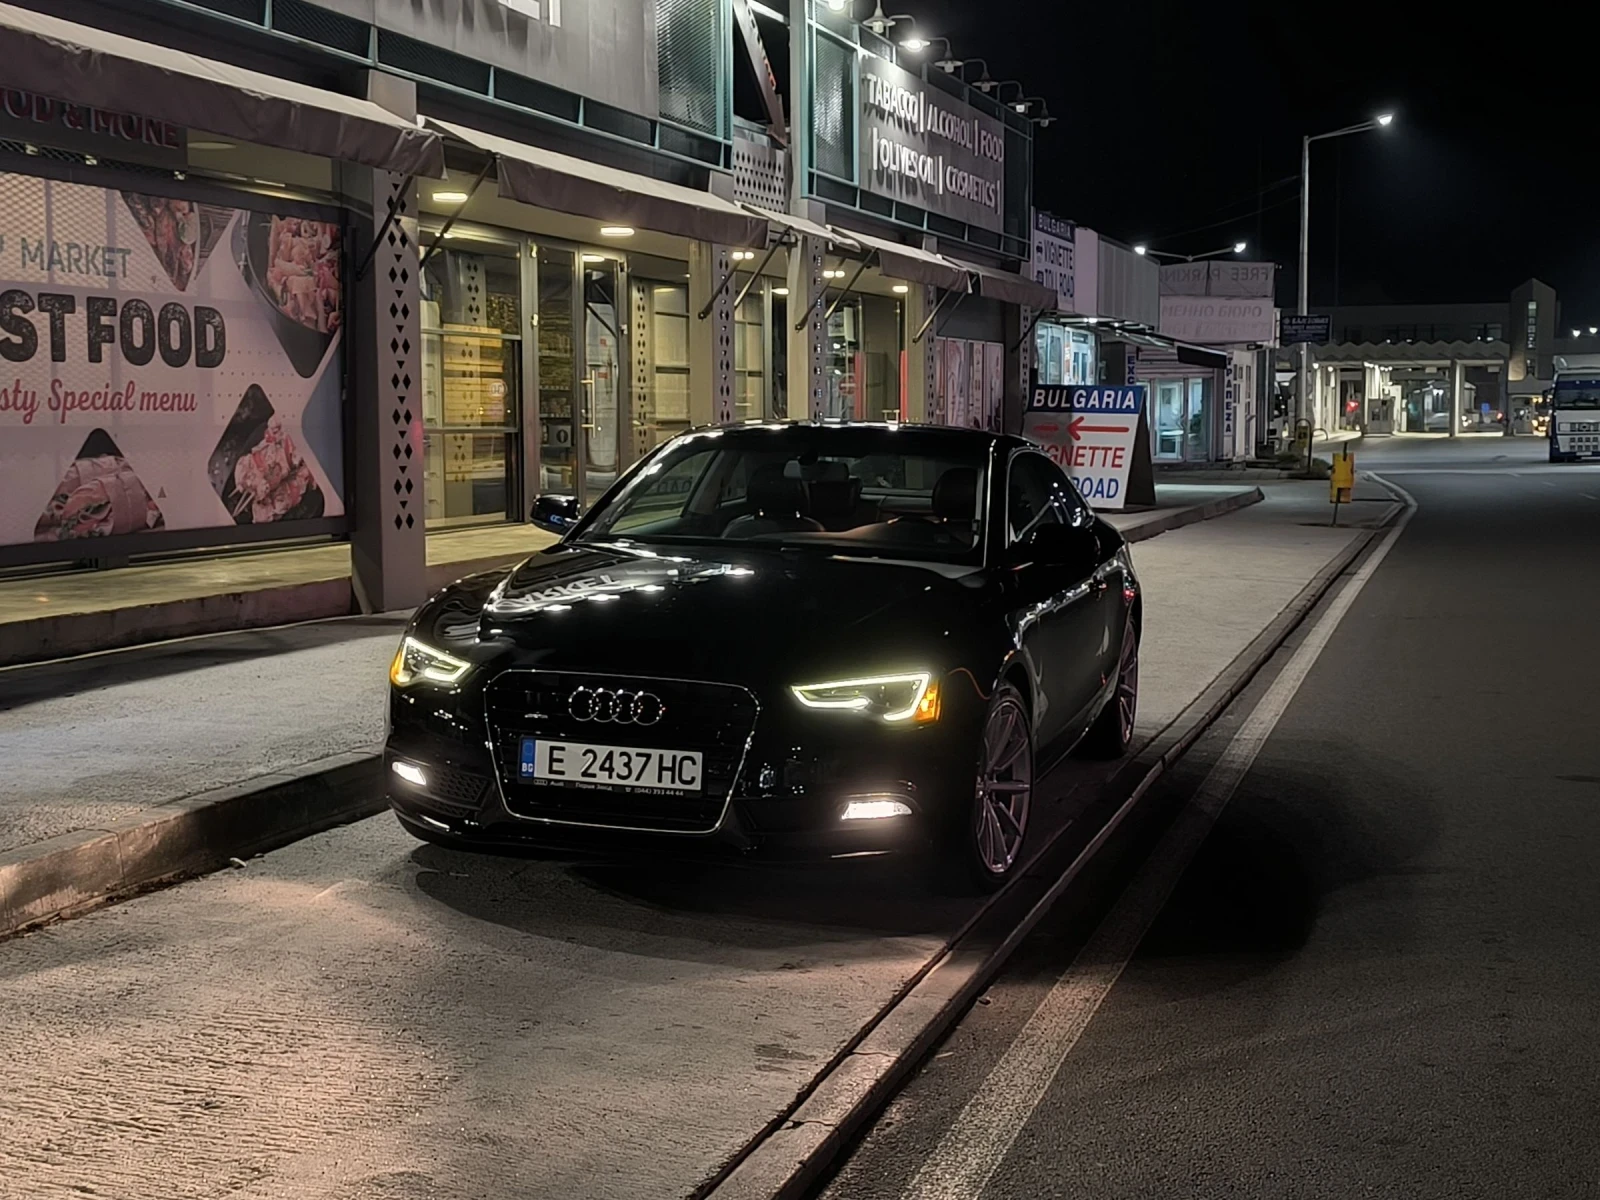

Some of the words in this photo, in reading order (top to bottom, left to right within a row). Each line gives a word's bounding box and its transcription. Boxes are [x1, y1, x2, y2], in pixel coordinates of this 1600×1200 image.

[0, 87, 54, 123] OD
[866, 74, 919, 124] TABACCO
[927, 103, 973, 152] ALCOHOL
[980, 130, 1005, 162] FOOD
[879, 138, 918, 179] OLIVES
[946, 165, 996, 208] COSMETICS
[1038, 213, 1072, 239] BULGARIA
[20, 237, 131, 278] MARKET
[1043, 239, 1073, 270] VIGNETTE
[86, 296, 226, 368] FOOD
[48, 379, 136, 424] Special
[139, 389, 198, 414] menu
[1033, 389, 1135, 409] BULGARIA
[521, 762, 534, 773] BG
[548, 745, 566, 775] E
[581, 748, 652, 782] 2437
[657, 753, 697, 786] HC
